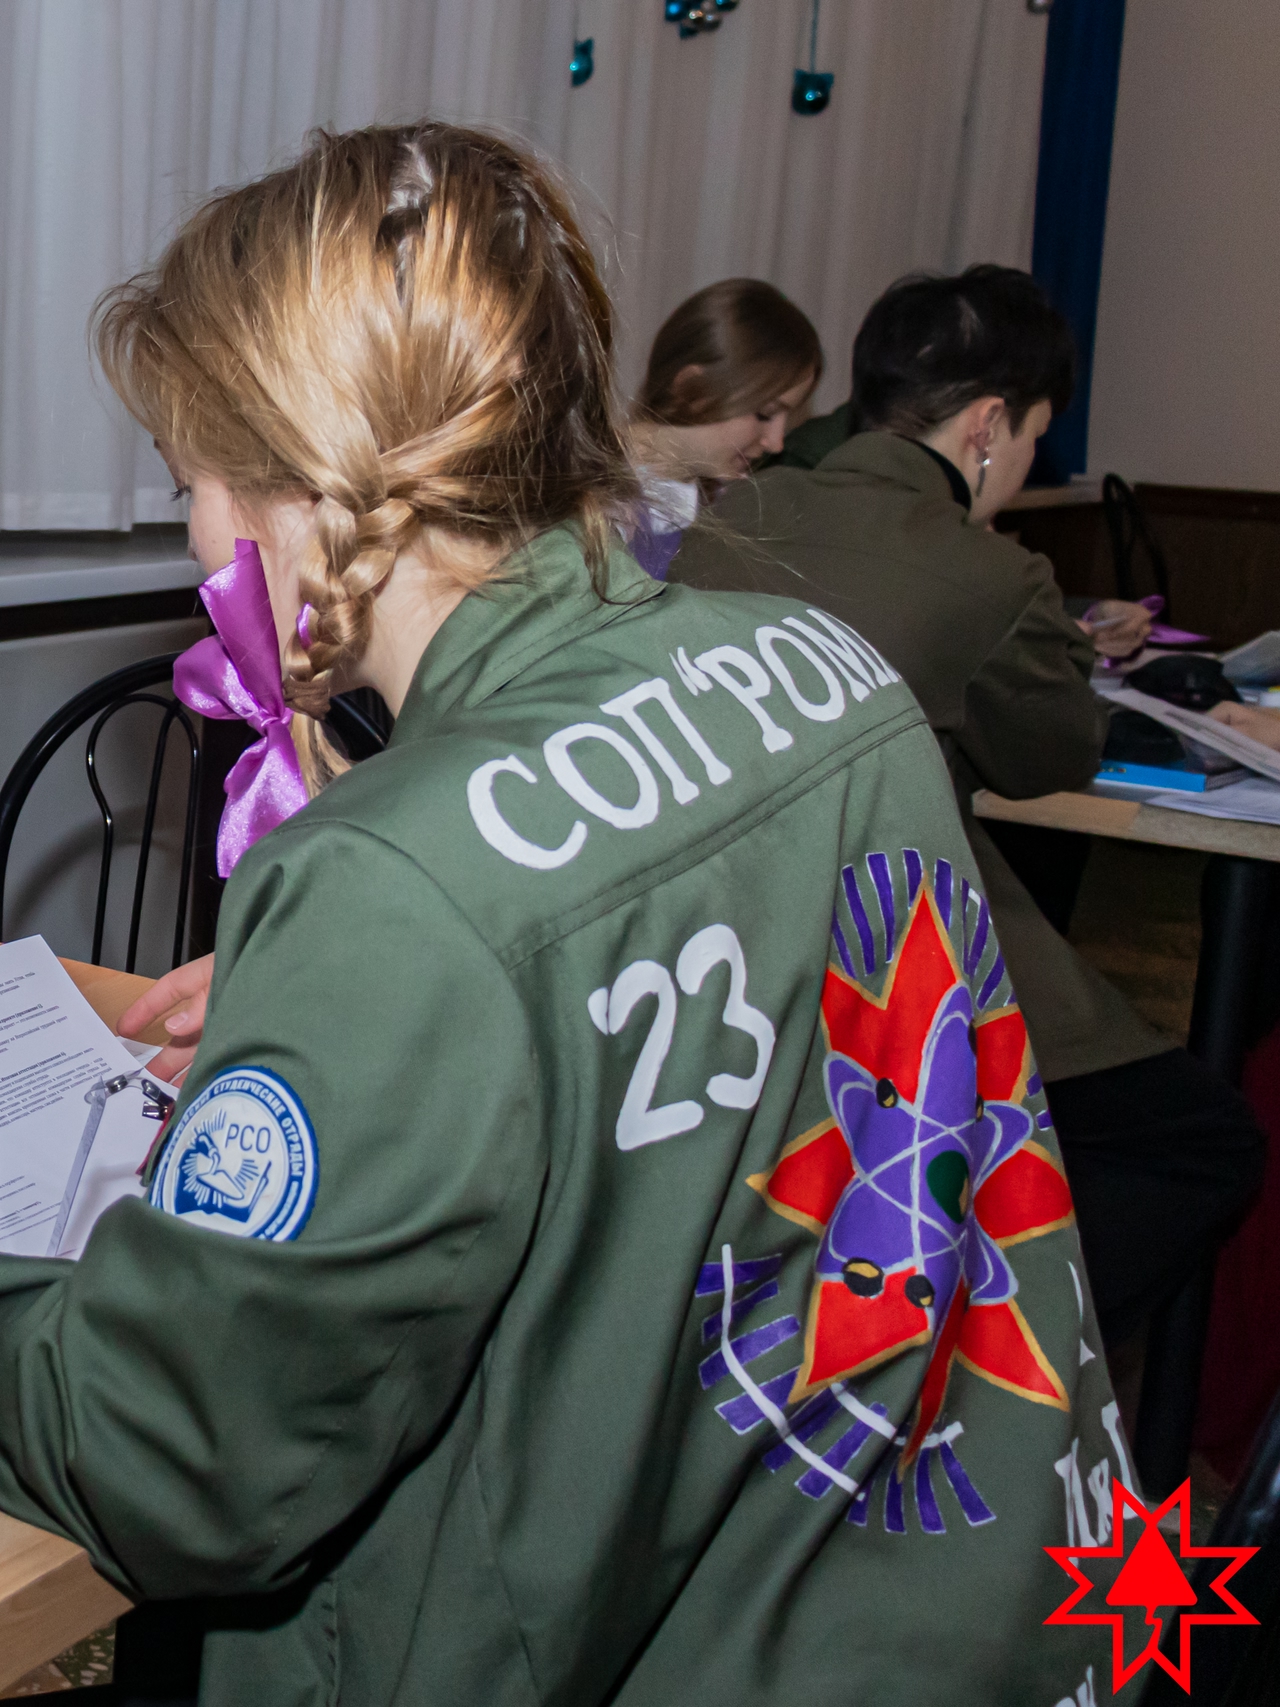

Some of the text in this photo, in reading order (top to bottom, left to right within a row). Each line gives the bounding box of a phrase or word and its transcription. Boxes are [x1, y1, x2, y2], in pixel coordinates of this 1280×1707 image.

[467, 679, 731, 869] СОП
[588, 923, 775, 1151] 23
[225, 1124, 271, 1153] РСО
[281, 1115, 304, 1177] ОТРЯДЫ
